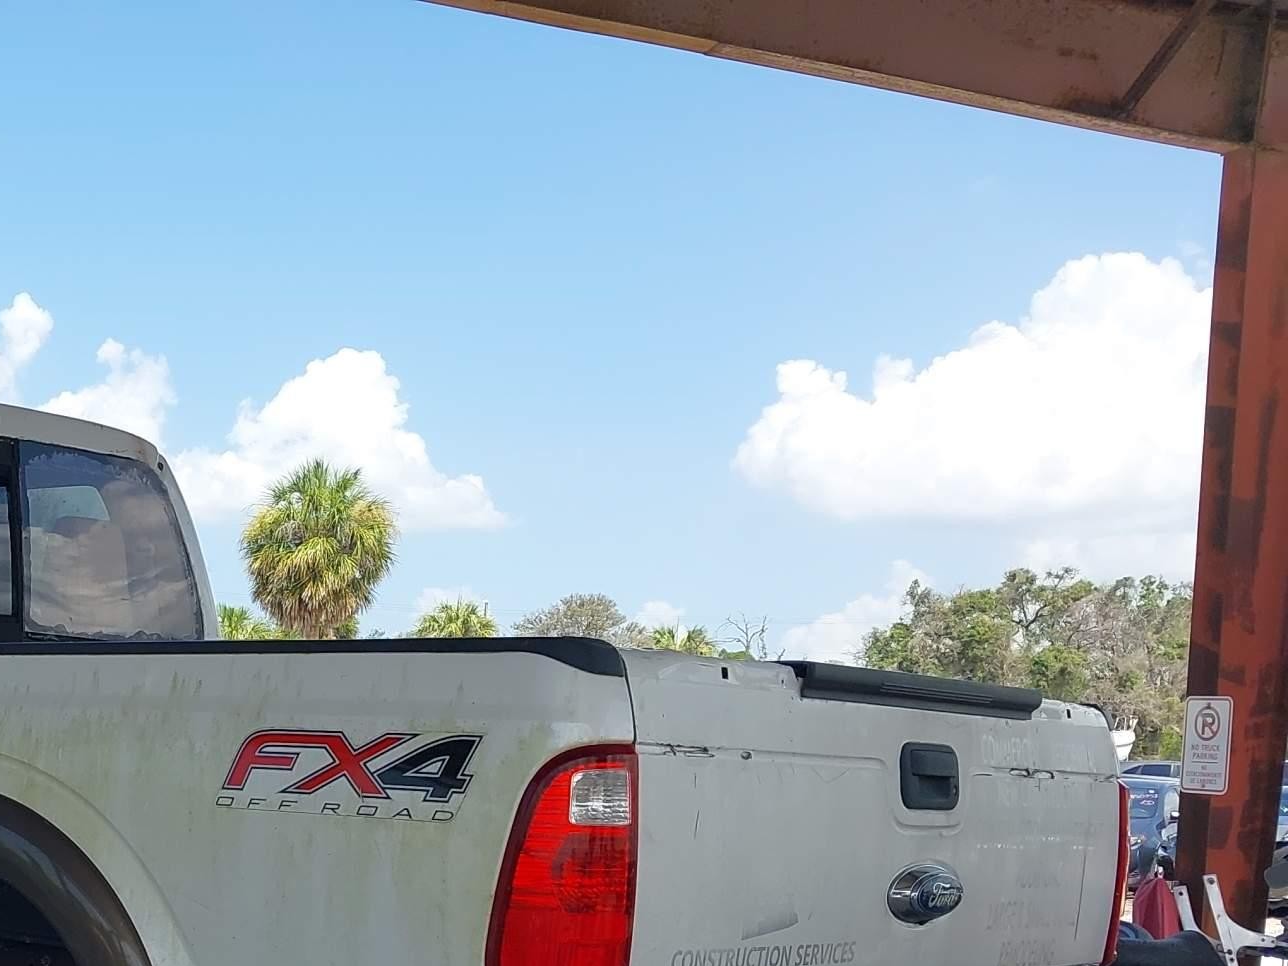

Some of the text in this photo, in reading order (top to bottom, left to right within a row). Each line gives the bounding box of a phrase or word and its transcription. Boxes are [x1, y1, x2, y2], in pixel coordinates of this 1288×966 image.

[221, 728, 484, 803] FX4
[216, 796, 455, 822] OFF ROAD
[928, 882, 962, 908] Ford
[795, 941, 857, 966] SERVICES
